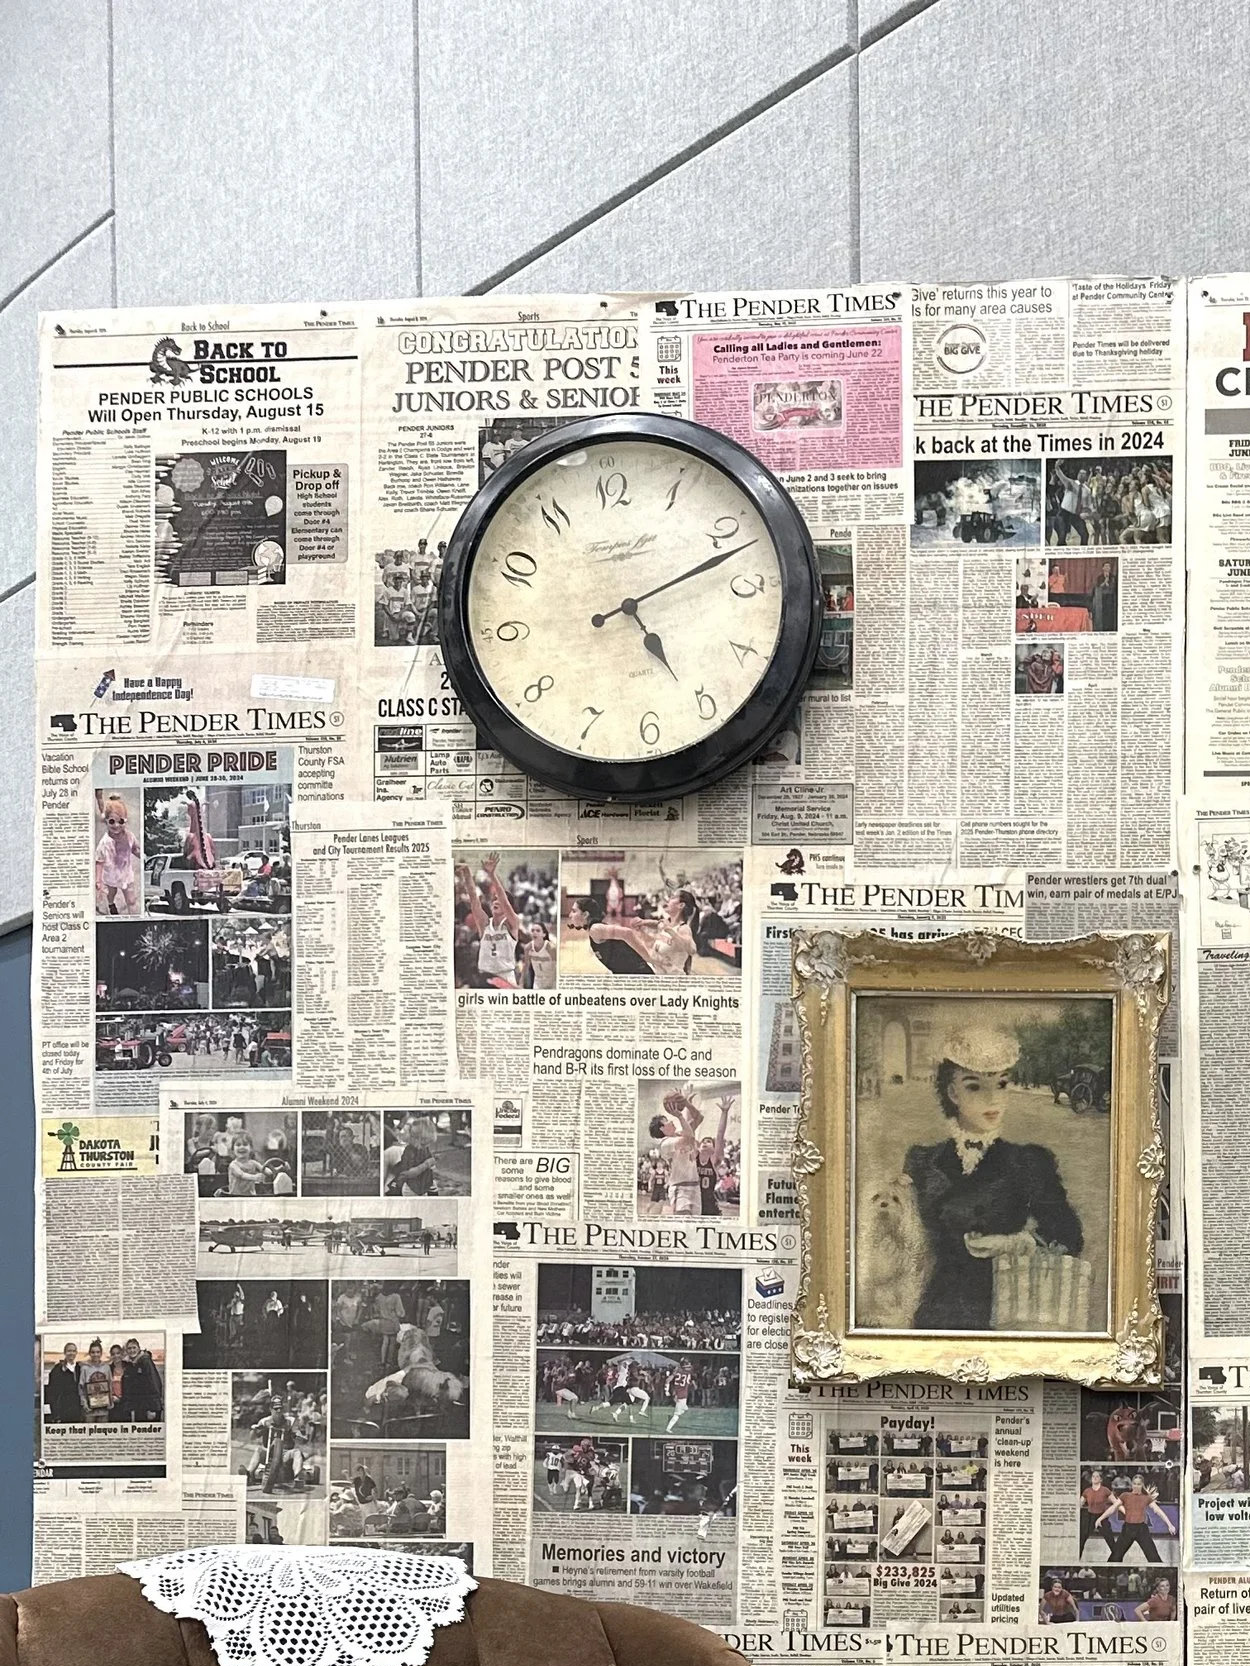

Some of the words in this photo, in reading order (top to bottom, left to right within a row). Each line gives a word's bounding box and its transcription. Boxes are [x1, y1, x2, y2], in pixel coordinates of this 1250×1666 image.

[680, 299, 727, 319] THE
[733, 298, 821, 317] PENDER
[827, 293, 896, 312] TIMES
[193, 341, 254, 360] BACK
[261, 341, 288, 358] TO
[712, 352, 759, 364] Penderton
[760, 352, 776, 362] Tea
[778, 352, 801, 363] Party
[801, 351, 809, 361] is
[810, 351, 845, 361] coming
[846, 350, 869, 359] June
[870, 348, 883, 358] 22
[713, 343, 749, 355] Calling
[751, 342, 764, 352] all
[766, 341, 798, 354] Ladies
[800, 340, 820, 350] and
[821, 340, 882, 352] Gentlemen:
[199, 365, 281, 384] SCHOOL
[405, 359, 534, 384] PENDER
[543, 357, 621, 381] POST
[99, 391, 165, 406] PENDER
[170, 389, 229, 404] PUBLIC
[234, 386, 313, 402] SCHOOLS
[392, 390, 511, 413] JUNIORS
[518, 389, 539, 410] &
[88, 409, 116, 423] Will
[121, 408, 162, 425] Open
[166, 406, 242, 422] Thursday,
[246, 404, 302, 421] August
[306, 403, 324, 416] 15
[932, 435, 975, 454] back
[980, 436, 998, 453] at
[1002, 434, 1032, 453] the
[1037, 434, 1093, 452] Times
[1099, 432, 1115, 451] in
[1121, 431, 1164, 450] 2024
[292, 469, 331, 481] Pickup
[332, 468, 342, 482] &
[295, 481, 323, 493] Drop
[324, 479, 340, 490] off
[595, 472, 631, 511] 12
[665, 479, 682, 511] 1
[540, 497, 571, 535] 11
[705, 516, 740, 549] 2
[501, 551, 537, 589] 10
[729, 573, 765, 599] 3
[496, 620, 531, 641] 9
[728, 640, 759, 669] 4
[524, 675, 554, 702] 8
[694, 685, 717, 720] 5
[79, 712, 132, 735] THE
[139, 712, 240, 733] PENDER
[246, 710, 326, 730] TIMES
[581, 706, 605, 740] 7
[639, 711, 660, 745] 6
[109, 752, 202, 775] PENDER
[207, 750, 278, 772] PRIDE
[458, 993, 485, 1008] girls
[487, 993, 509, 1005] win
[512, 993, 546, 1006] battle
[548, 994, 562, 1006] of
[564, 994, 627, 1007] unbeatens
[629, 997, 657, 1007] over
[659, 995, 690, 1011] Lady
[693, 995, 740, 1011] Knights
[79, 1139, 121, 1150] DAKOTA
[79, 1150, 135, 1162] THURSTON
[535, 1157, 571, 1174] BIG
[880, 1416, 935, 1432] Payday!
[542, 1543, 625, 1562] Memories
[630, 1546, 662, 1563] and
[667, 1547, 726, 1569] victory
[876, 1565, 936, 1579] $233,825
[873, 1577, 888, 1590] Big
[890, 1577, 911, 1588] Give
[913, 1578, 938, 1588] 2024
[1200, 1587, 1238, 1600] Return
[1193, 1604, 1216, 1618] pair
[1218, 1602, 1230, 1615] of
[894, 1634, 950, 1656] THE
[957, 1634, 1060, 1656] PENDER
[1066, 1634, 1148, 1655] TIMES
